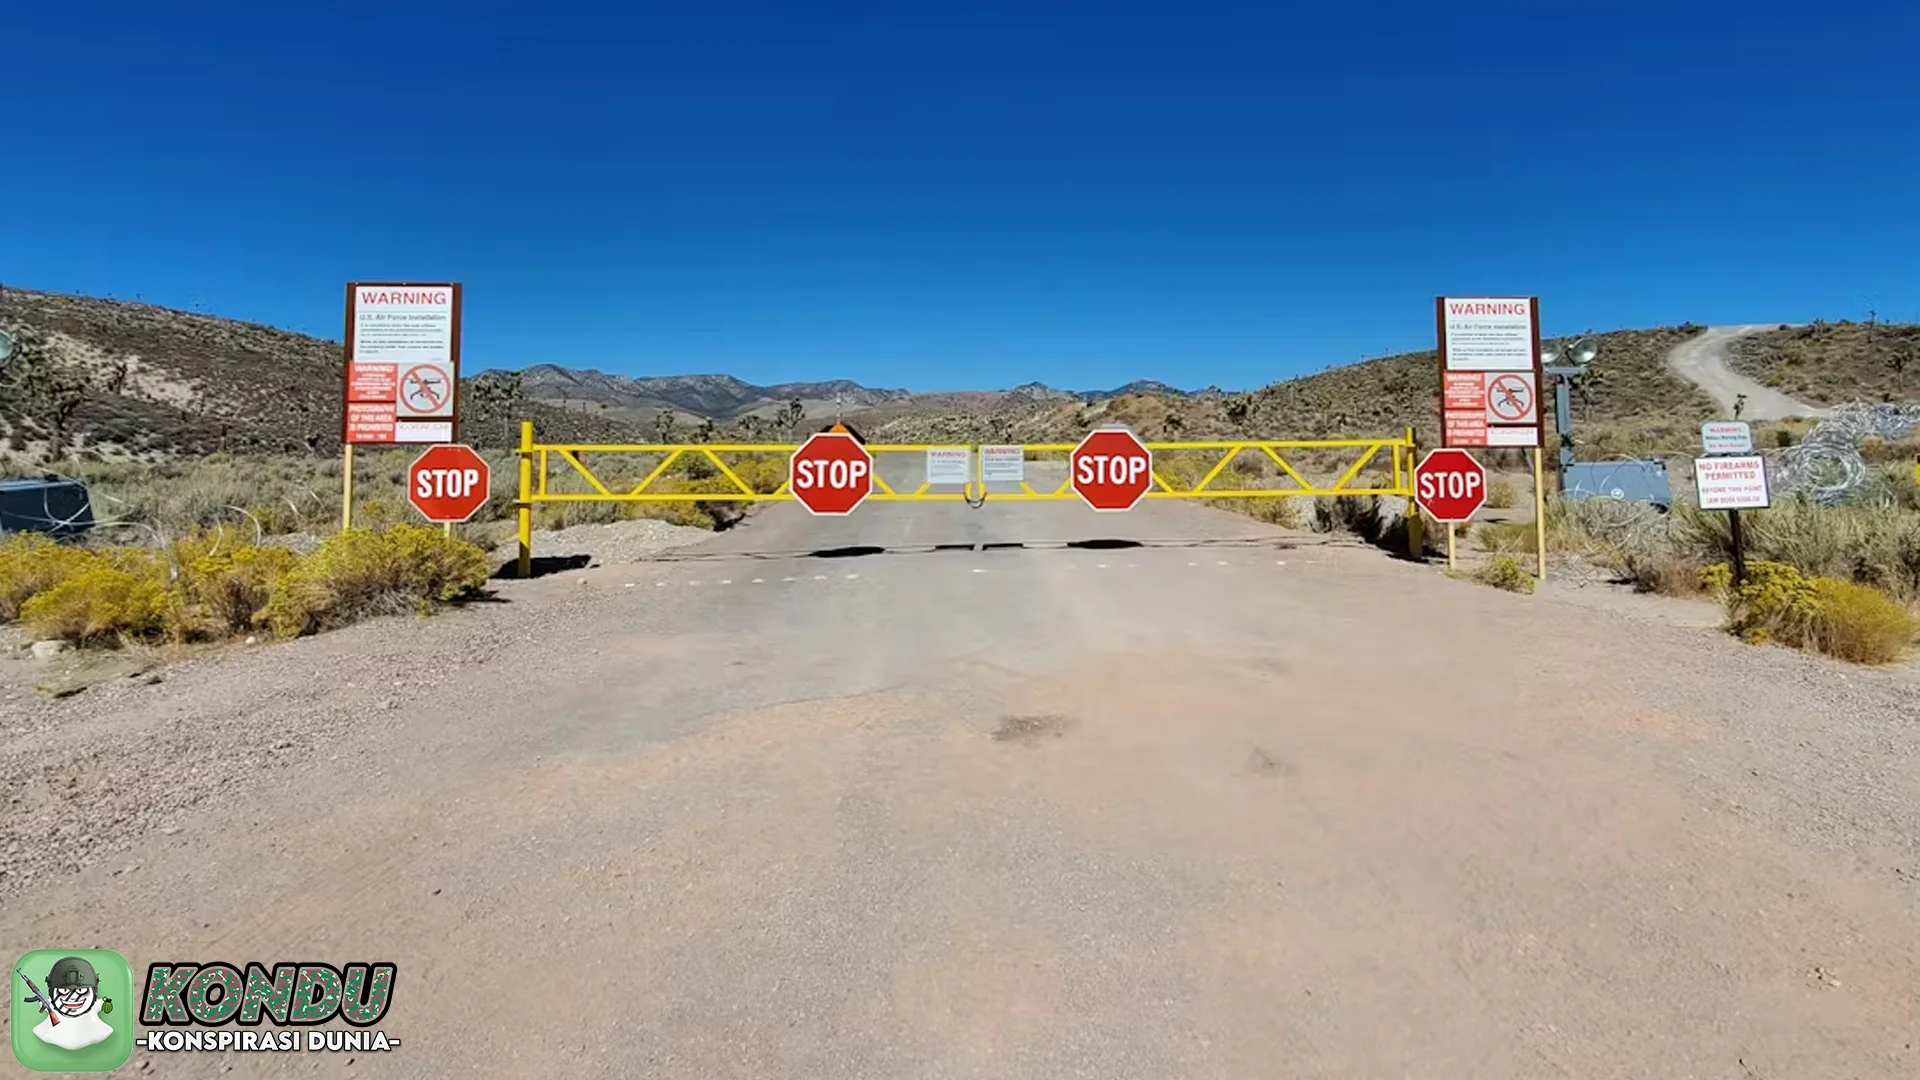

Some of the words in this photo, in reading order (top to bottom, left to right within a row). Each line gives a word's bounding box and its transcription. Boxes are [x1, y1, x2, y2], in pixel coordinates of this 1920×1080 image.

[362, 292, 447, 304] WARNING
[1449, 304, 1525, 315] WARNING
[796, 459, 867, 489] STOP
[1077, 455, 1147, 485] STOP
[1698, 463, 1713, 471] NO
[1714, 461, 1760, 470] FIREARMS
[1705, 471, 1756, 480] PERMITTED
[417, 469, 479, 498] STOP
[1420, 471, 1481, 499] STOP
